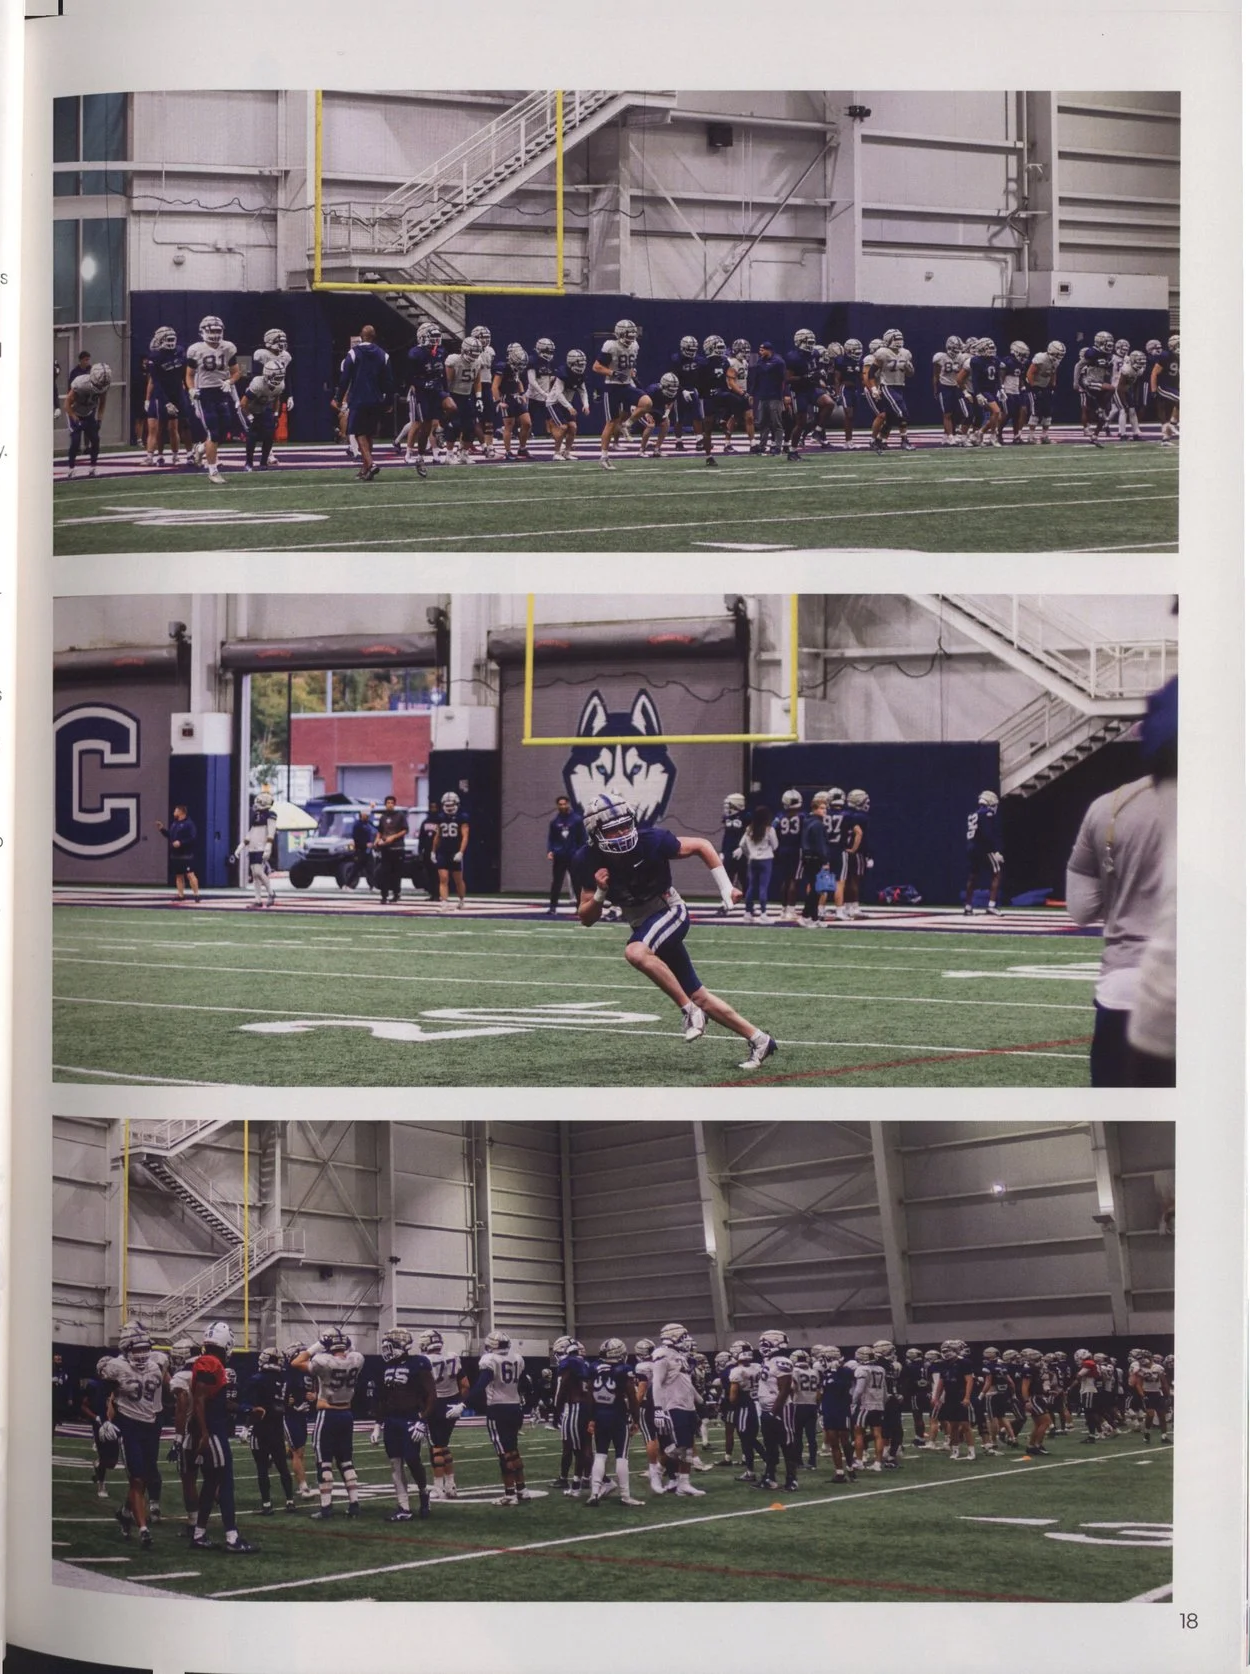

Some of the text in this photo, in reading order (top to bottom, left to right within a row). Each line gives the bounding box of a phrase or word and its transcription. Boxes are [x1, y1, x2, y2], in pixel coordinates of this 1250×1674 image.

[202, 354, 226, 372] 81
[53, 701, 141, 860] C
[439, 822, 459, 838] 26
[779, 815, 801, 837] 93
[431, 1358, 458, 1382] 77
[500, 1361, 520, 1385] 61
[1179, 1612, 1199, 1630] 18
